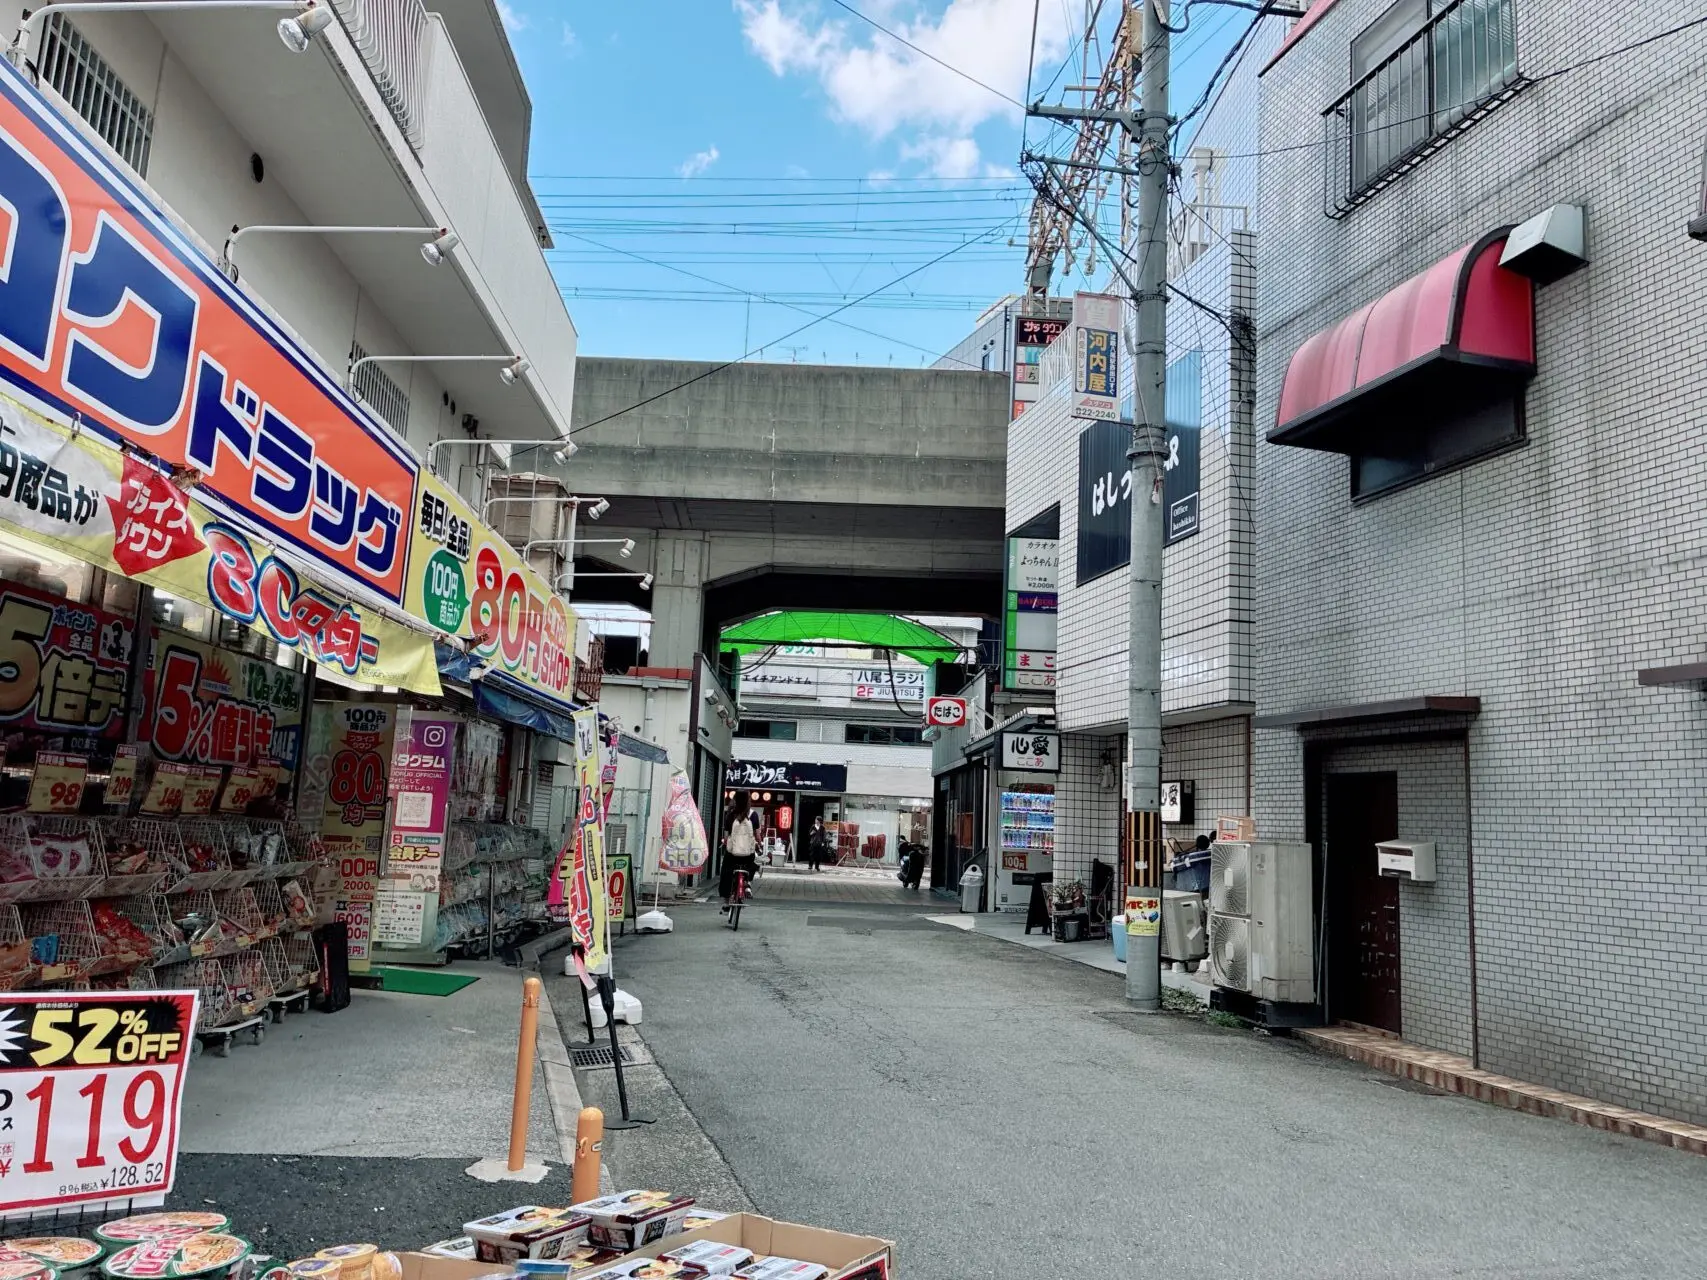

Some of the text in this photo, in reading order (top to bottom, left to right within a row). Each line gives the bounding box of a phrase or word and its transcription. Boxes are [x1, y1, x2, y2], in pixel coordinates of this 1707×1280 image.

[1088, 331, 1108, 393] 河内屋
[430, 560, 458, 600] 100円
[69, 633, 94, 651] 全品
[541, 641, 570, 694] SHOP
[743, 674, 811, 685] エイチアンドエム
[933, 702, 961, 718] たばこ
[1012, 736, 1050, 756] 心愛
[51, 782, 80, 806] 98
[116, 1033, 181, 1062] OFF
[23, 1070, 166, 1174] 119
